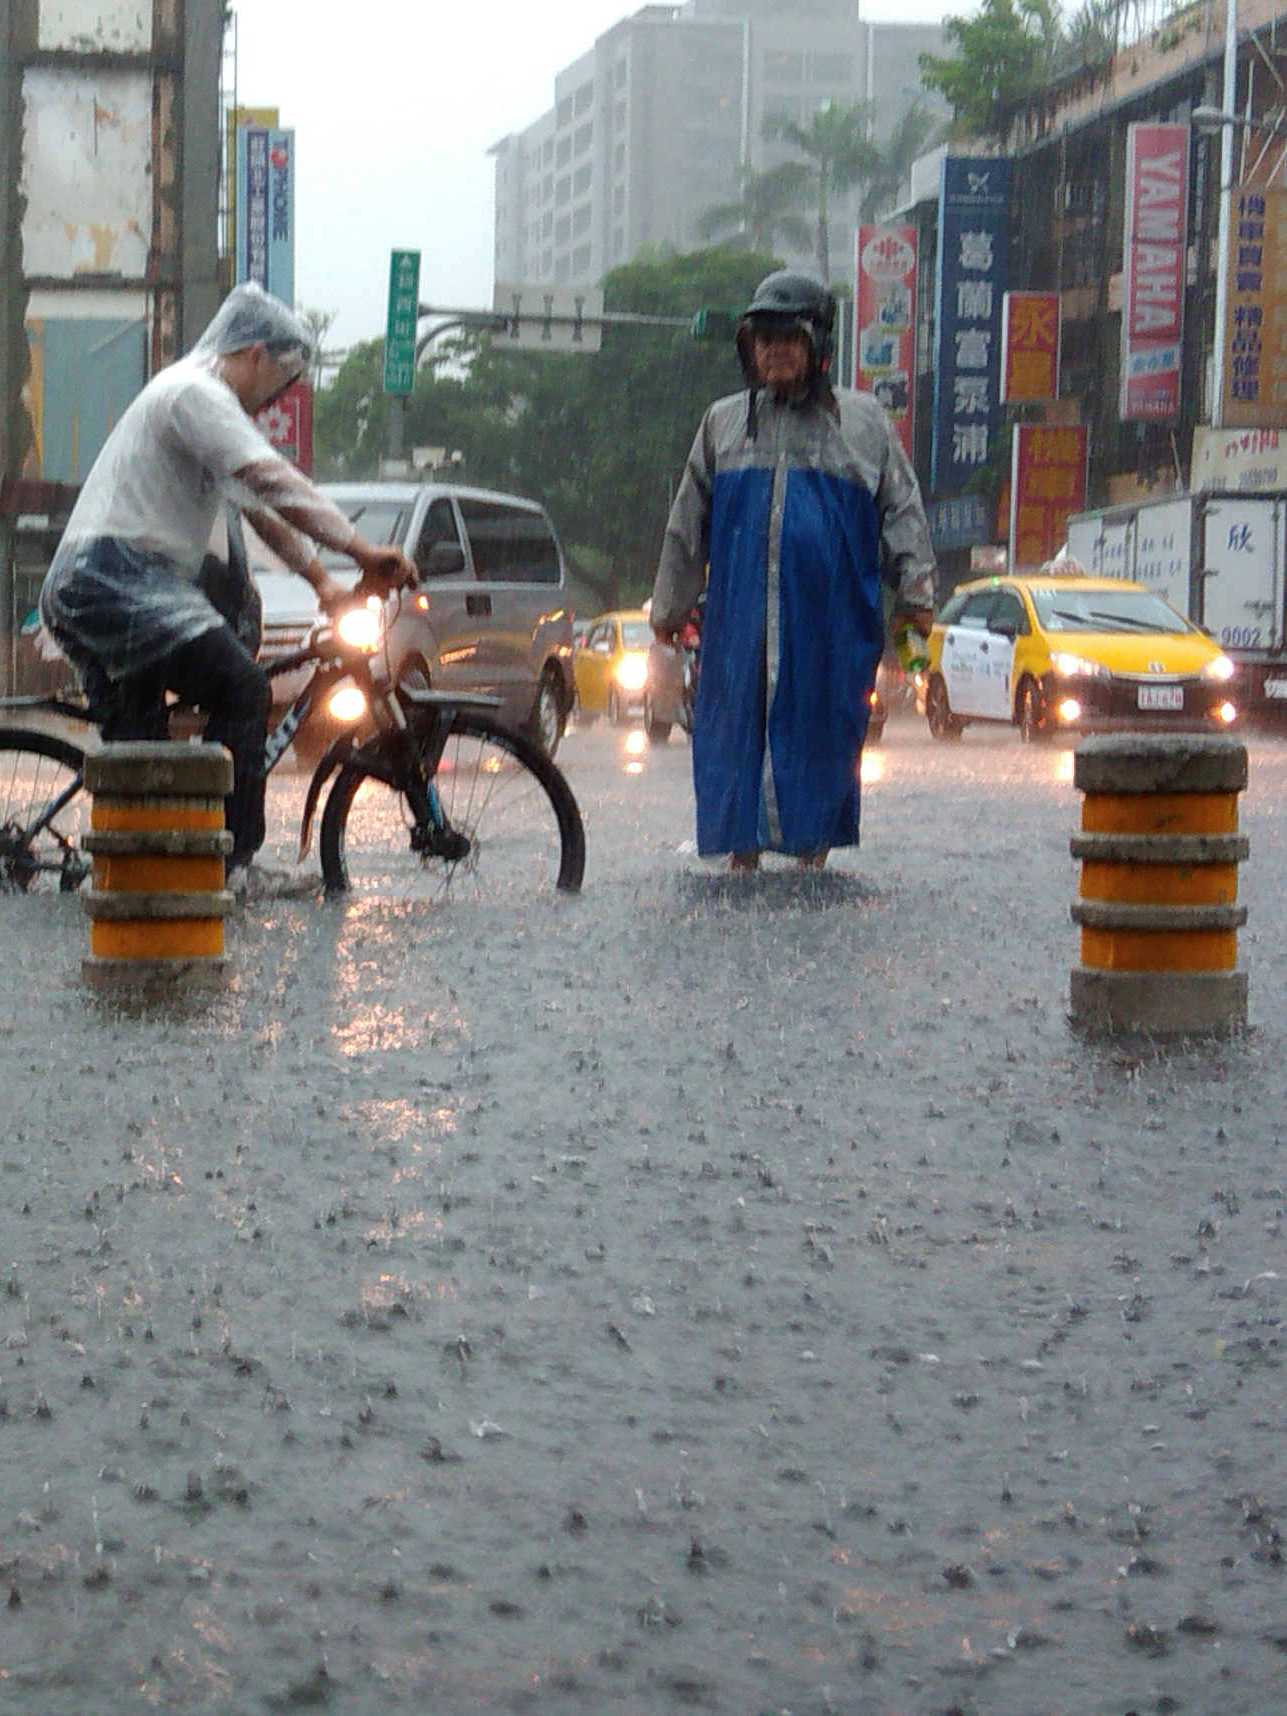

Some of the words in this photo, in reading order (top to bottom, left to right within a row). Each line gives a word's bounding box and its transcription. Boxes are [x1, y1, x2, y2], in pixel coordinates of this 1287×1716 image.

[1134, 151, 1181, 333] YAMAHA
[952, 231, 993, 464] 葛蘭富泵浦
